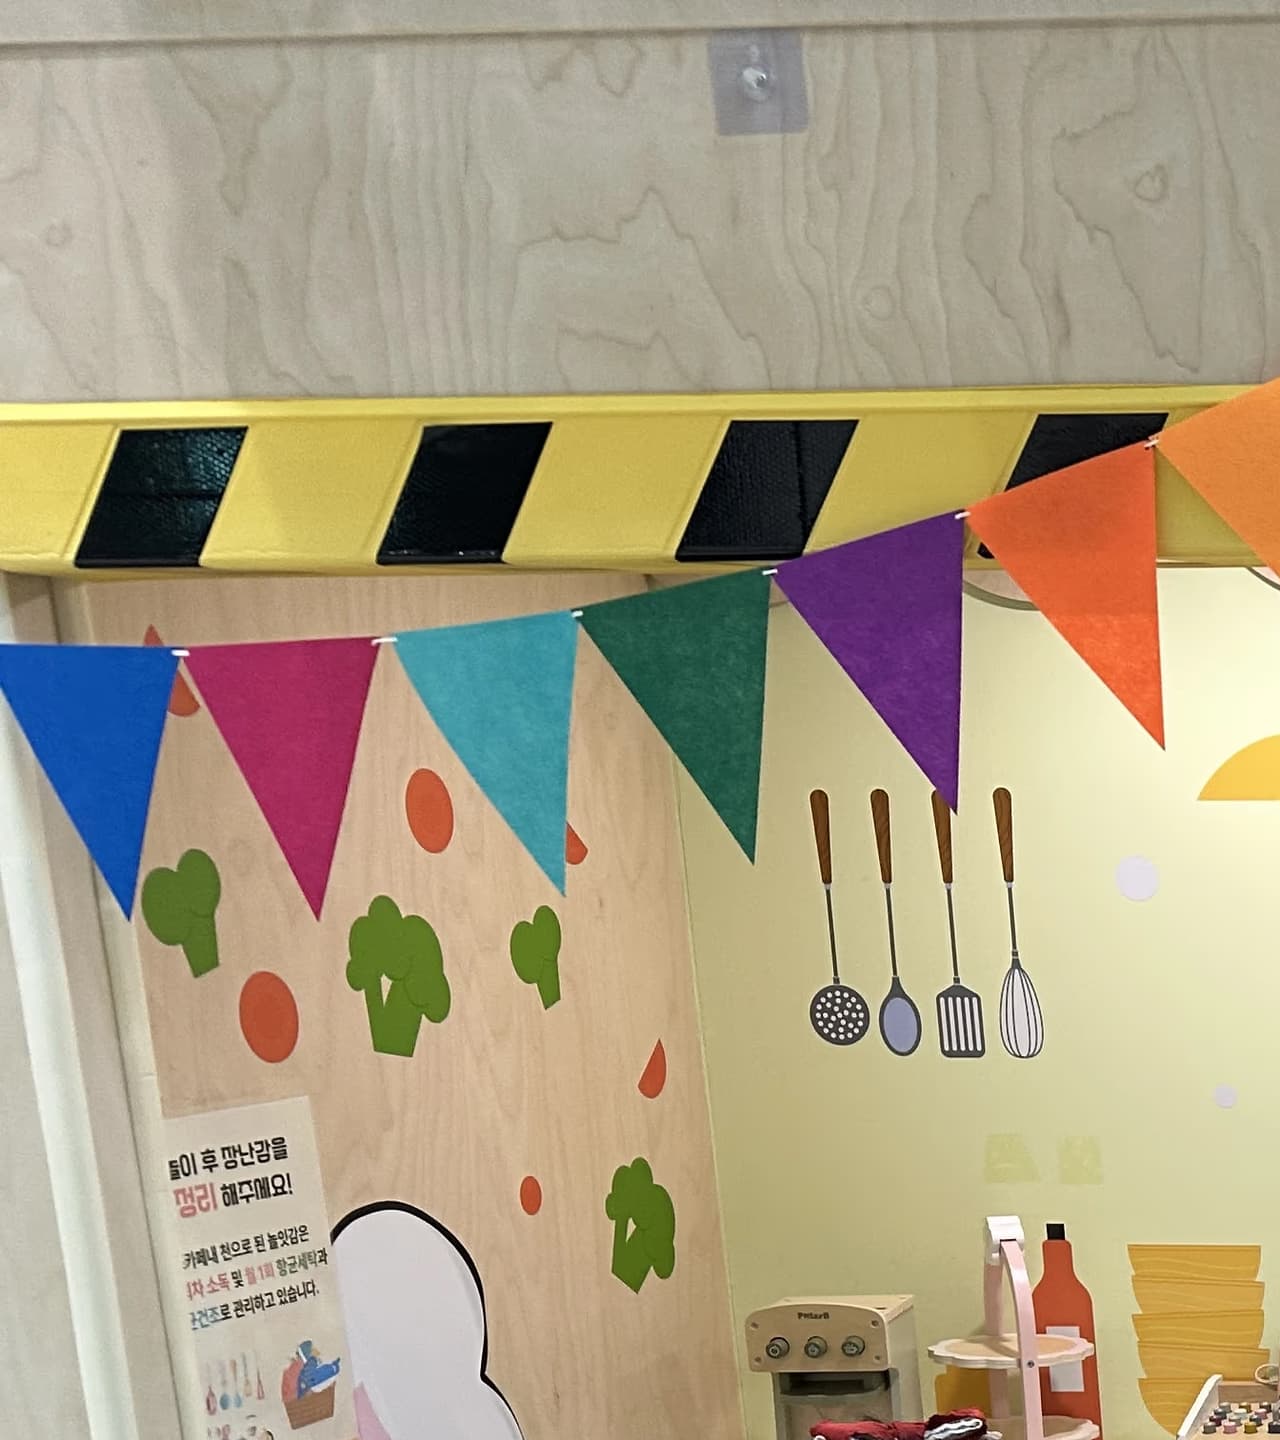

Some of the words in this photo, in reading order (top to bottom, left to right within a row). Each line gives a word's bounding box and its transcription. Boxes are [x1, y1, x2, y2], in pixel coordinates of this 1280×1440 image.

[201, 1148, 219, 1173] 후
[220, 1136, 289, 1170] 장난감을
[173, 1182, 218, 1218] 정리
[219, 1238, 254, 1261] 천으로
[254, 1234, 267, 1253] 된
[267, 1224, 309, 1250] 놀잇감은
[207, 1272, 230, 1294] 소독
[231, 1268, 245, 1289] 및
[233, 1292, 277, 1319] 관리하고
[277, 1279, 320, 1306] 있습니다.
